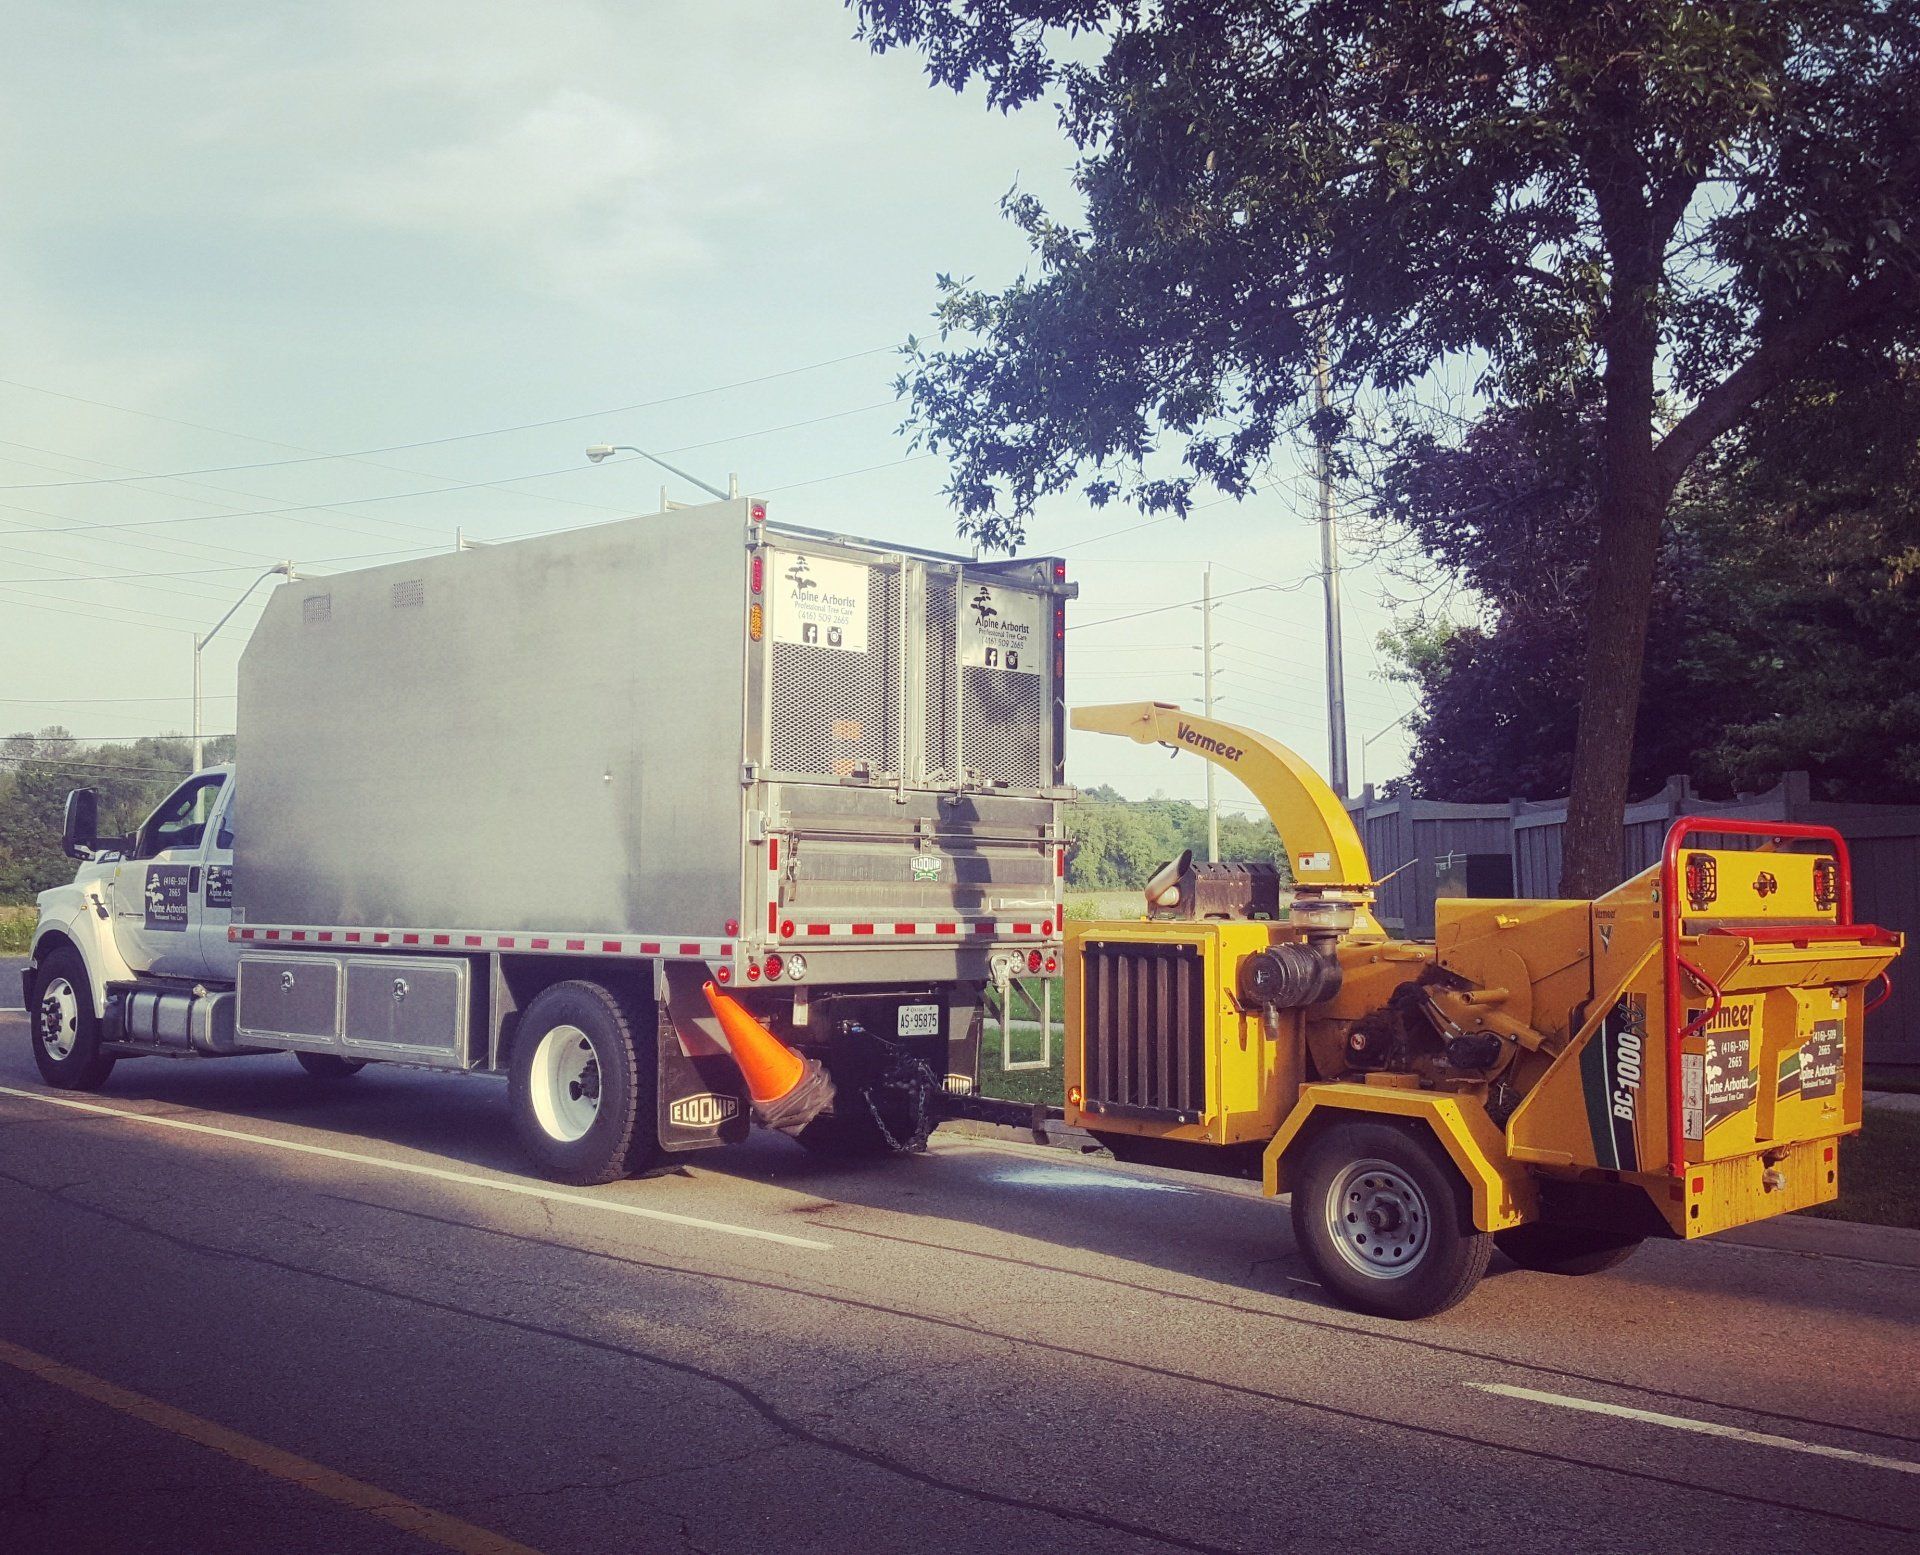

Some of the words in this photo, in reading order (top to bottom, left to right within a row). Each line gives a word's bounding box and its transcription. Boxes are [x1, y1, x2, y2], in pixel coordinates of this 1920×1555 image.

[791, 589, 819, 602] Alpine
[822, 593, 856, 607] Arborist
[795, 601, 826, 612] Professional
[828, 605, 839, 614] Tree
[841, 607, 853, 616] Care
[798, 610, 816, 621] (416)
[818, 613, 832, 623] 509
[833, 616, 849, 625] 2665
[975, 616, 998, 629] Alpine
[1001, 621, 1029, 633] Arborist
[1010, 641, 1024, 649] 2665
[1177, 721, 1243, 762] Vermeer
[169, 888, 181, 897] 2665
[149, 902, 165, 914] Alpine
[166, 902, 187, 914] Arborist
[1721, 1039, 1749, 1054] (416)-509
[1818, 1045, 1830, 1055] 2665
[1728, 1056, 1742, 1068] 2665
[1815, 1063, 1836, 1078] Arborist
[1724, 1076, 1749, 1092] Arborist
[674, 1097, 736, 1124] ELOQUIP
